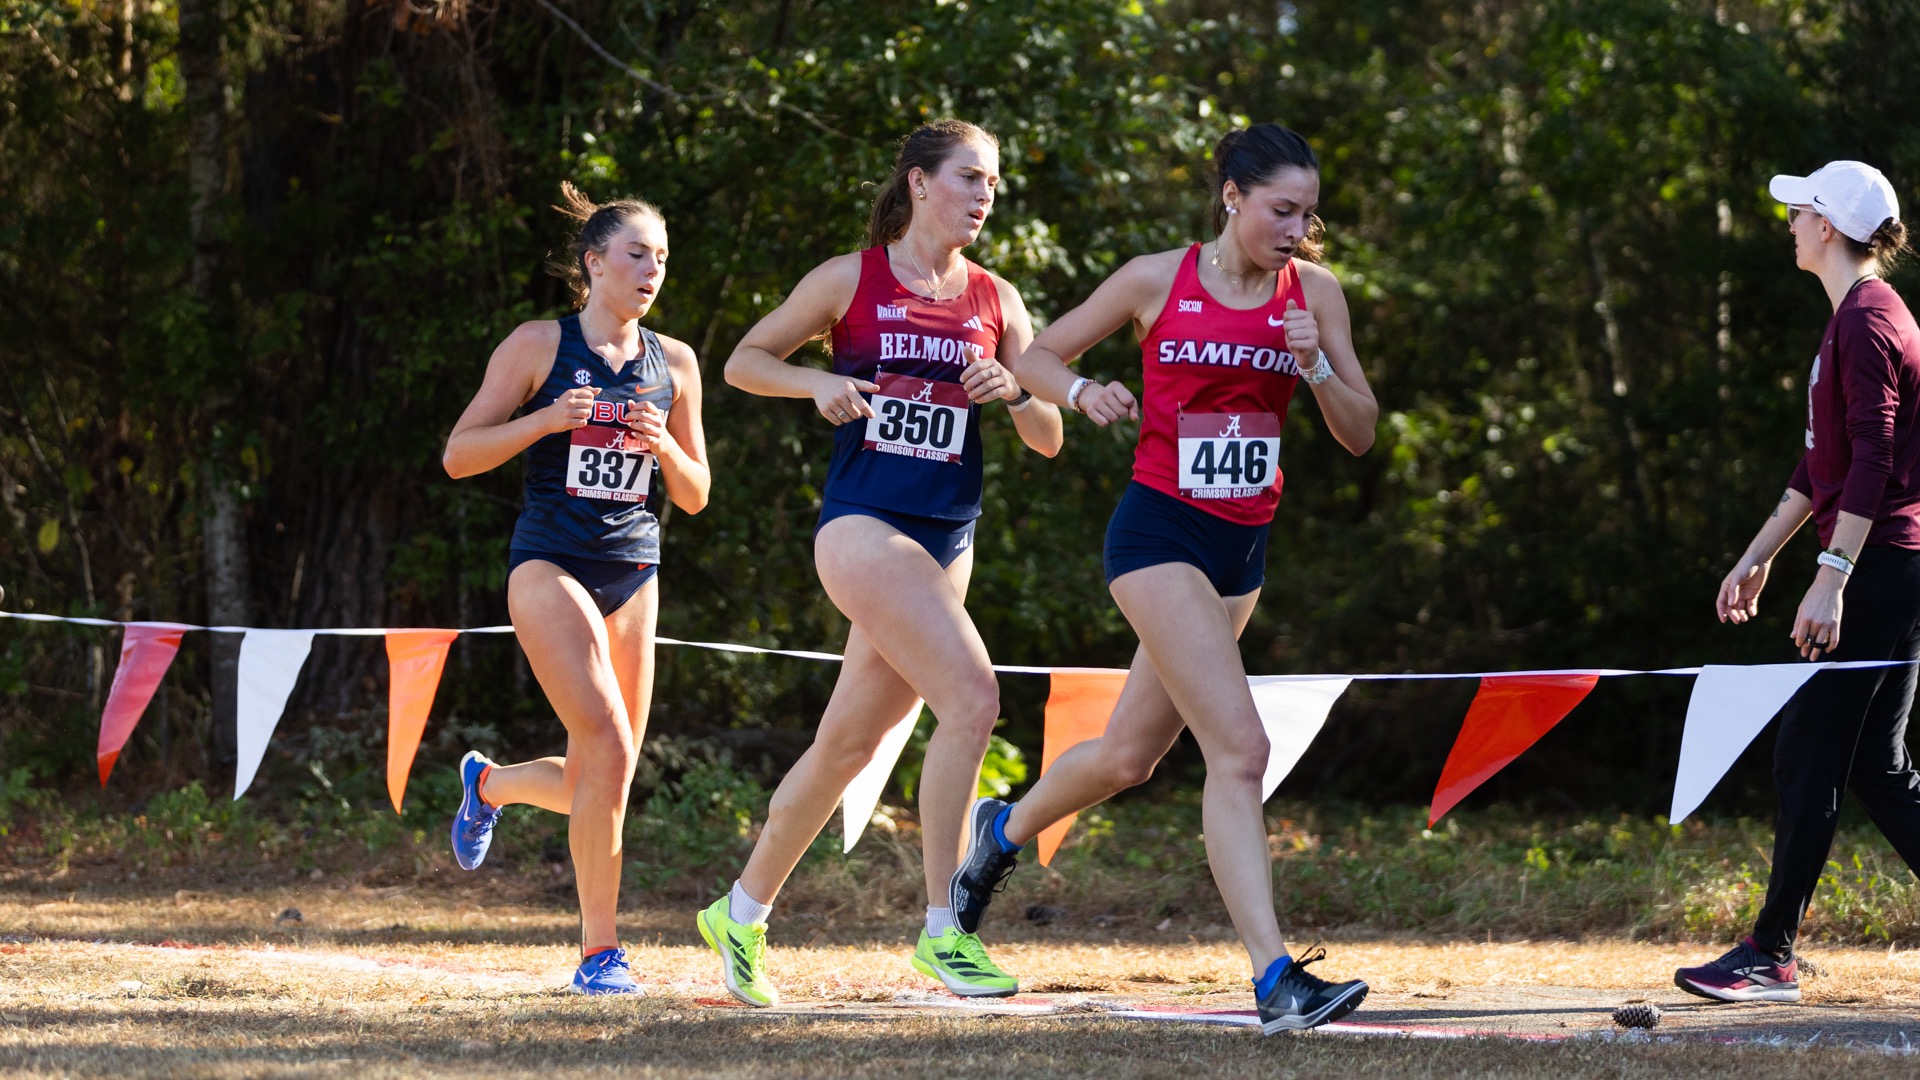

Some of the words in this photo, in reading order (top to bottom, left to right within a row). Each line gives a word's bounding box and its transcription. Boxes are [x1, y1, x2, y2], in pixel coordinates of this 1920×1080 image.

[877, 304, 908, 319] VALLEY
[574, 369, 592, 385] SEC
[911, 381, 934, 403] A
[878, 399, 955, 449] 350
[1219, 415, 1242, 438] A
[876, 442, 915, 457] CRIMSON
[916, 448, 950, 462] CLASSIC
[1191, 440, 1269, 485] 446
[578, 448, 645, 491] 337
[576, 488, 612, 500] CRIMSON
[613, 491, 640, 503] CLASSIC
[1191, 487, 1232, 499] CRIMSON
[1233, 486, 1264, 498] CLASSIC
